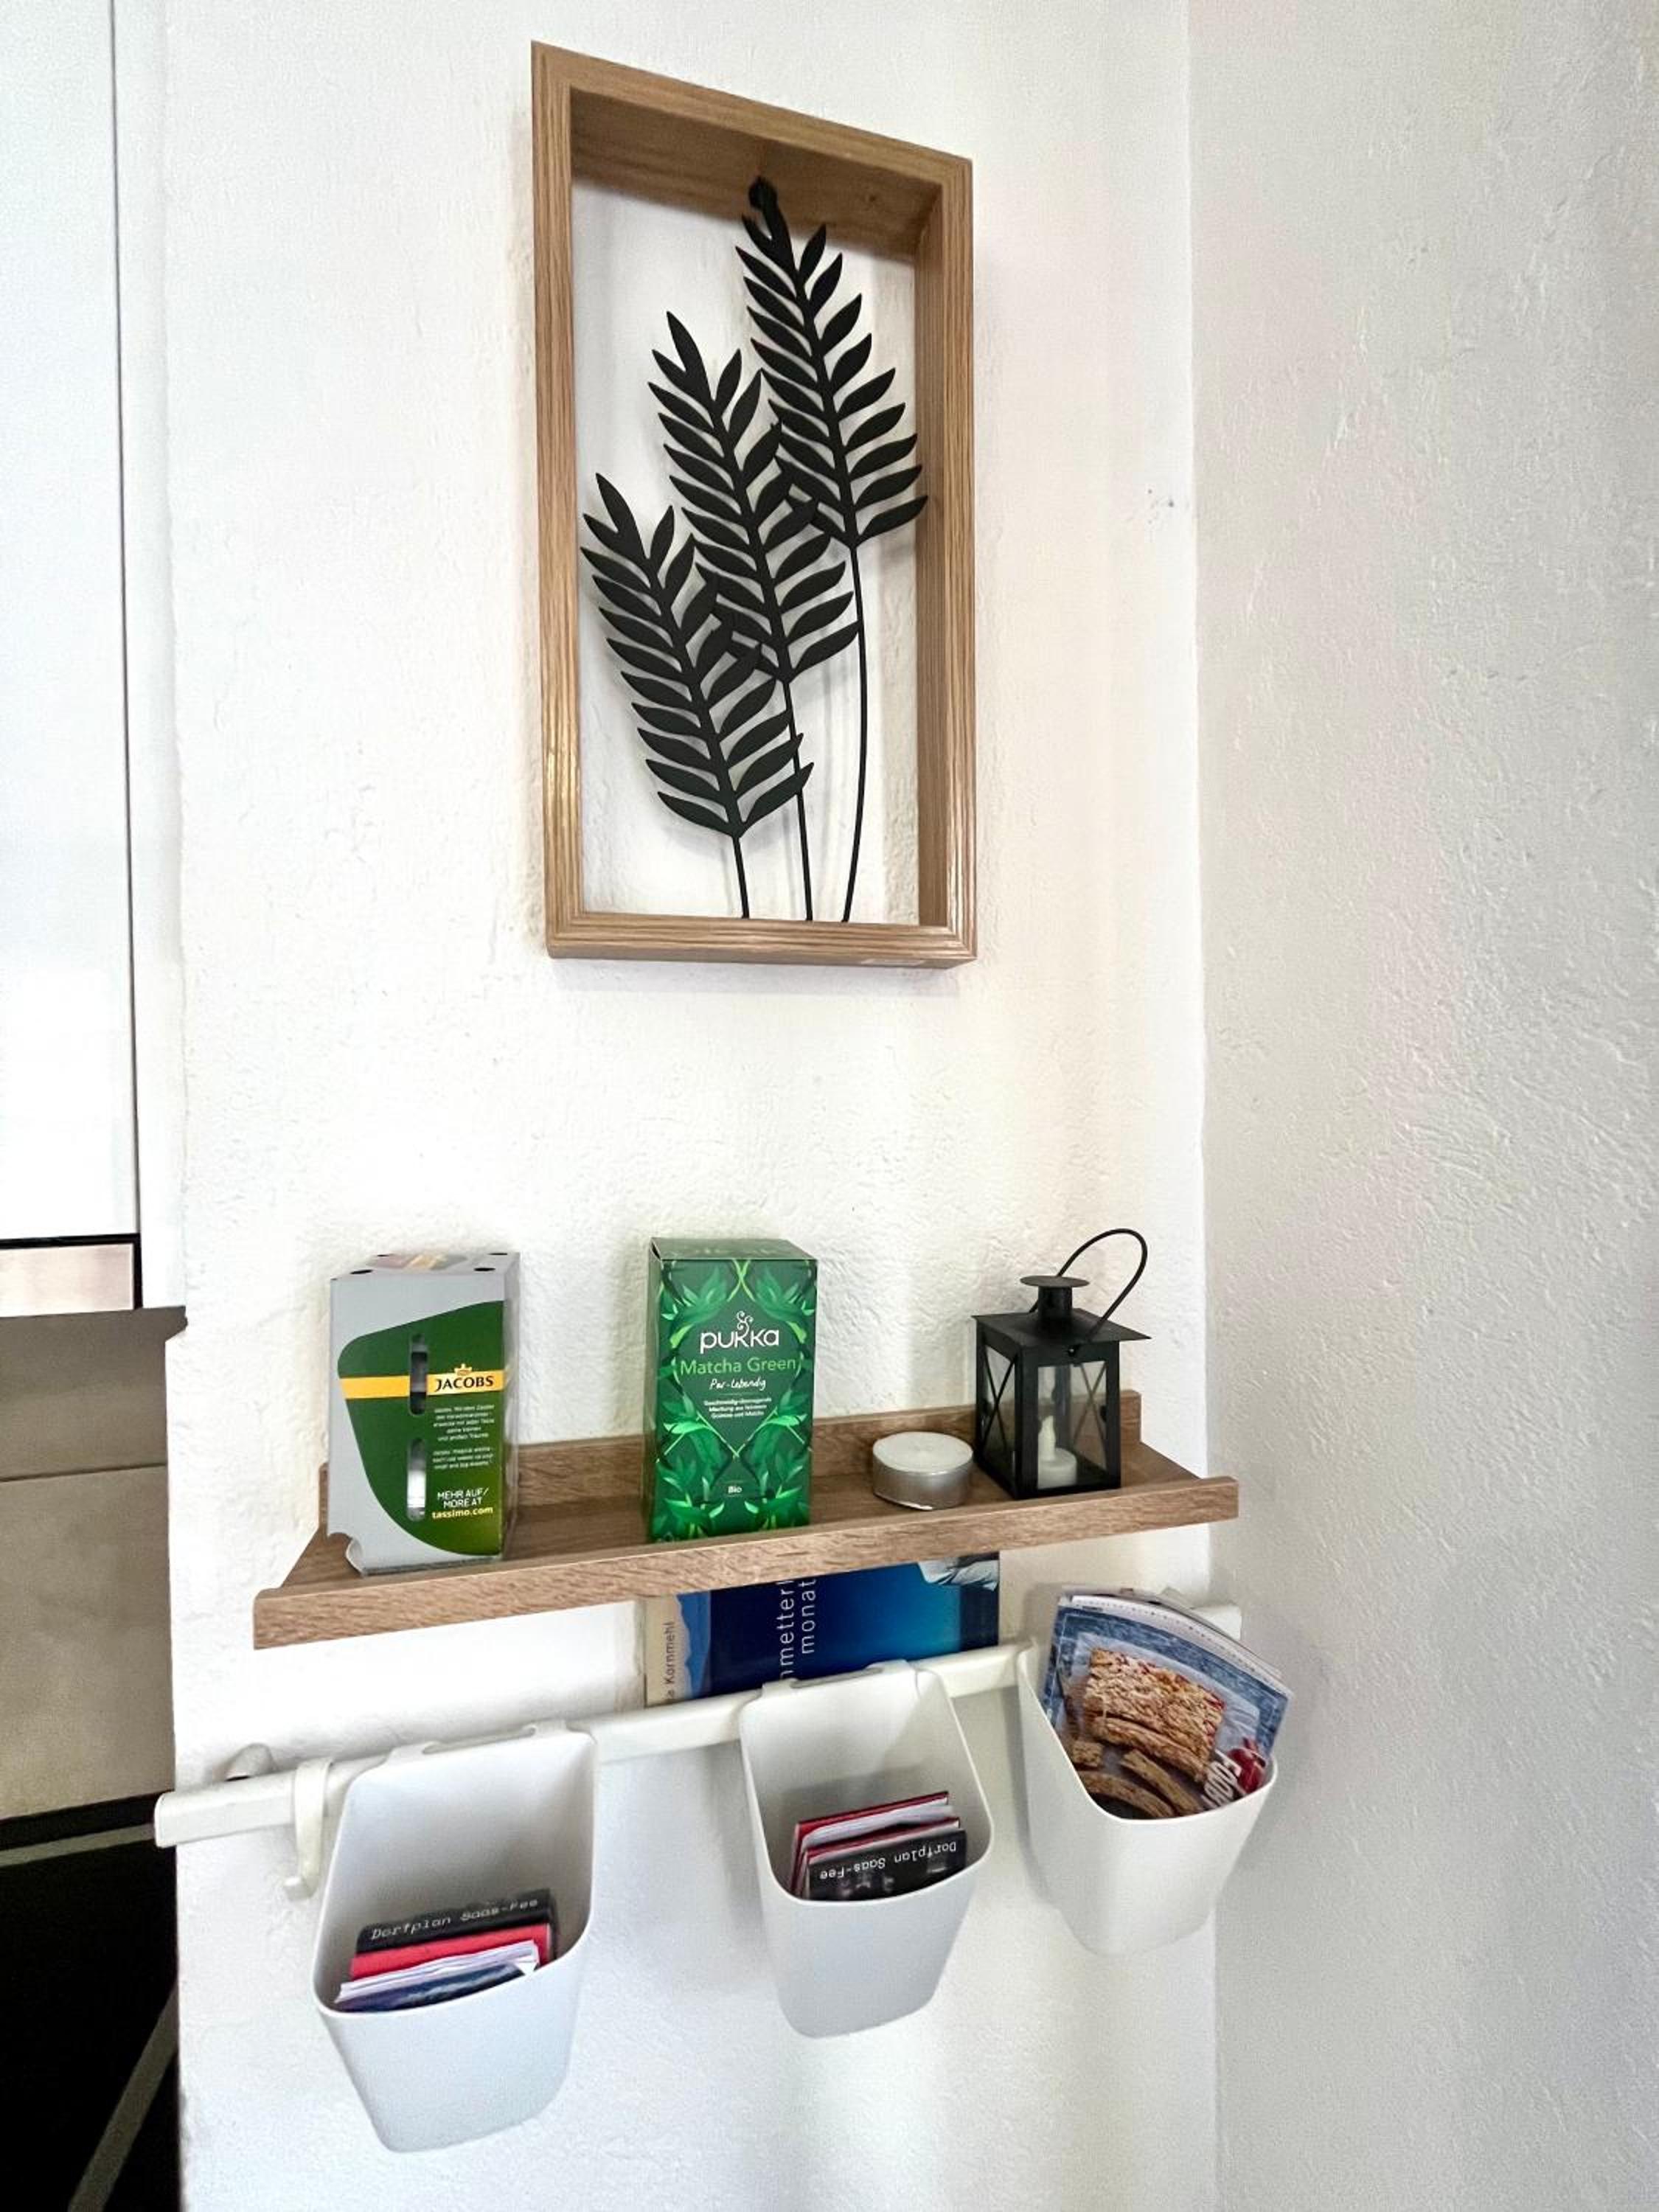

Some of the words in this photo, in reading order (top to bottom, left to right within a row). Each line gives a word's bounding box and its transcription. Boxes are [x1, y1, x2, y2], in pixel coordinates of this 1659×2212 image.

[700, 1320, 779, 1354] pukka
[681, 1357, 742, 1375] Matcha
[747, 1356, 796, 1373] Green
[435, 1375, 494, 1393] JACOBS
[437, 1489, 464, 1501] MEHR
[728, 1485, 742, 1494] Bio
[443, 1498, 470, 1509] MORE
[472, 1496, 483, 1507] AT
[431, 1506, 494, 1520] tassimo.com
[798, 1578, 817, 1655] monat
[894, 1841, 957, 1863] Dorfplan
[819, 1857, 886, 1879] Saas-Fee
[371, 1917, 451, 1941] Dorfplan
[460, 1899, 538, 1921] Saas-Fee
